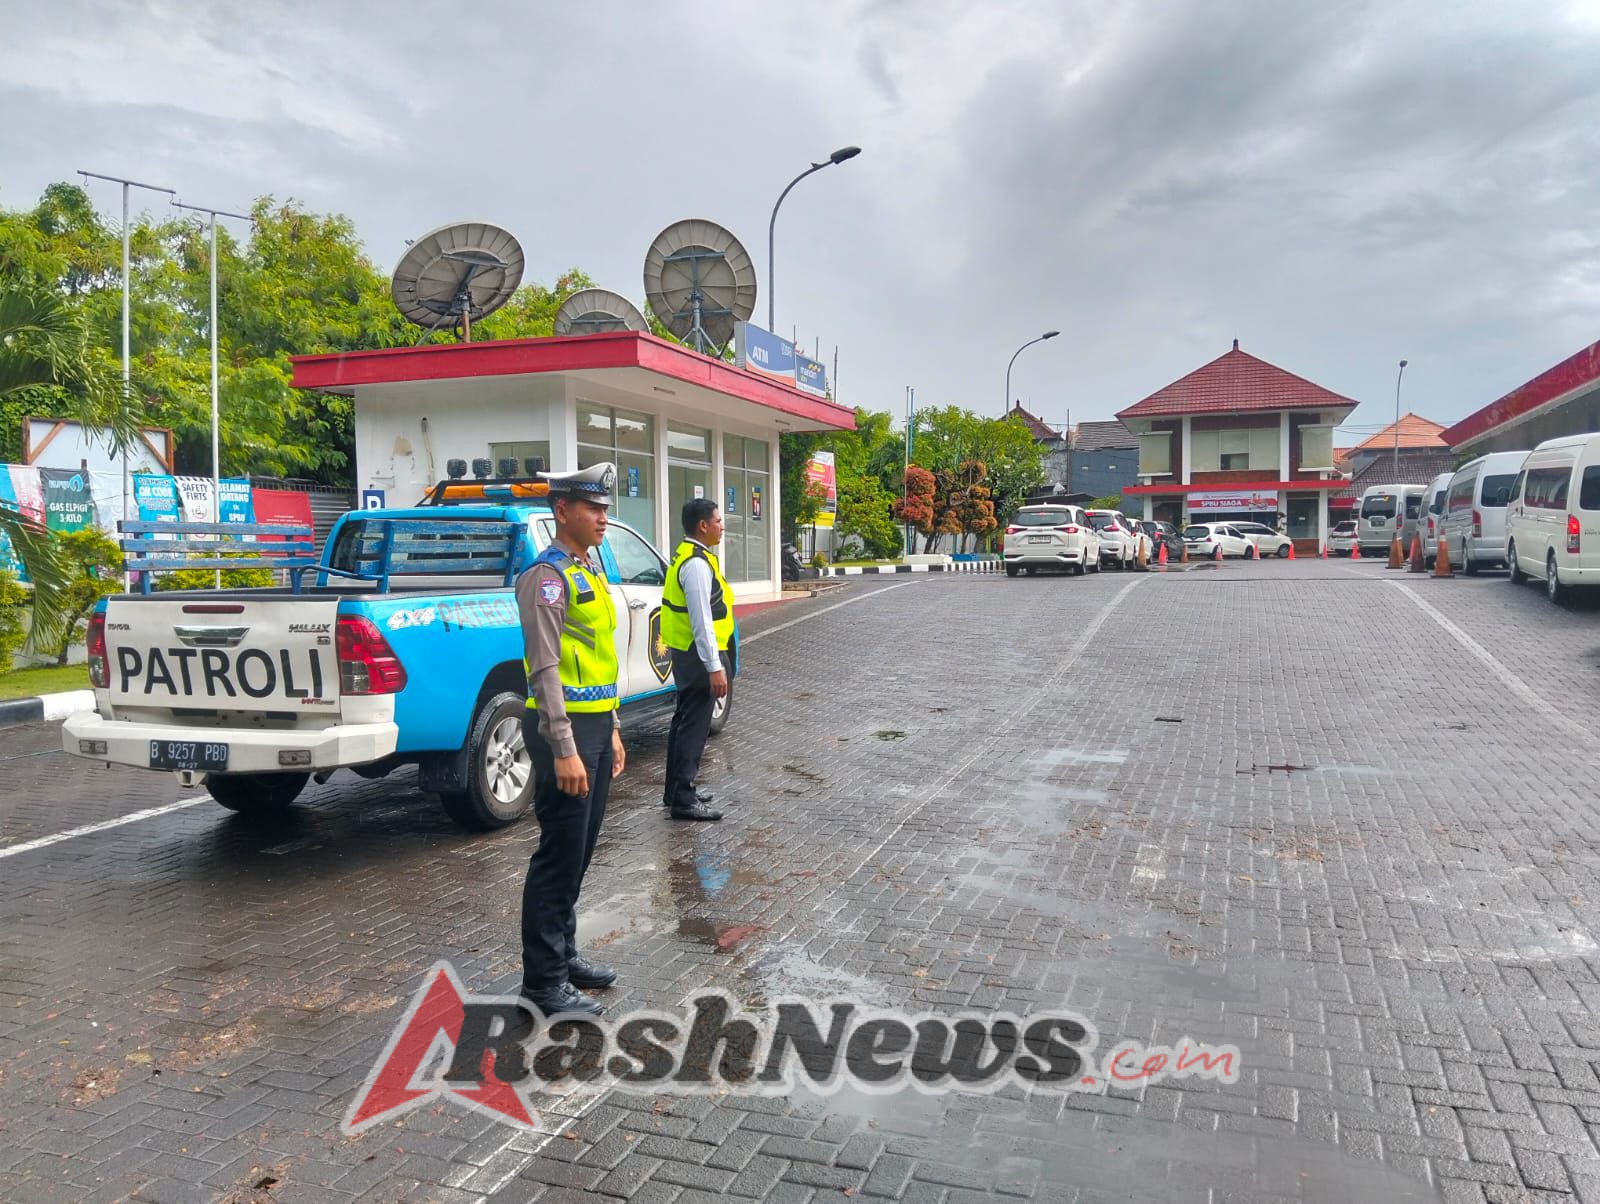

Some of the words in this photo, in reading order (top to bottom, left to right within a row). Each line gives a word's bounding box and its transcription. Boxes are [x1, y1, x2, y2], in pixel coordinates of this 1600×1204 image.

[752, 345, 769, 364] ATM
[139, 486, 151, 497] QR
[152, 486, 173, 497] CODE
[182, 483, 208, 493] SAFETY
[218, 483, 251, 493] SELAMAT
[186, 492, 208, 501] FIRTS
[220, 492, 249, 503] DATANG
[49, 502, 64, 512] GAS
[65, 503, 88, 513] ELPIGI
[1200, 500, 1219, 508] SPBU
[117, 646, 323, 698] PATROLI
[151, 742, 159, 758] B
[168, 743, 196, 760] 9257
[205, 744, 227, 761] PBD
